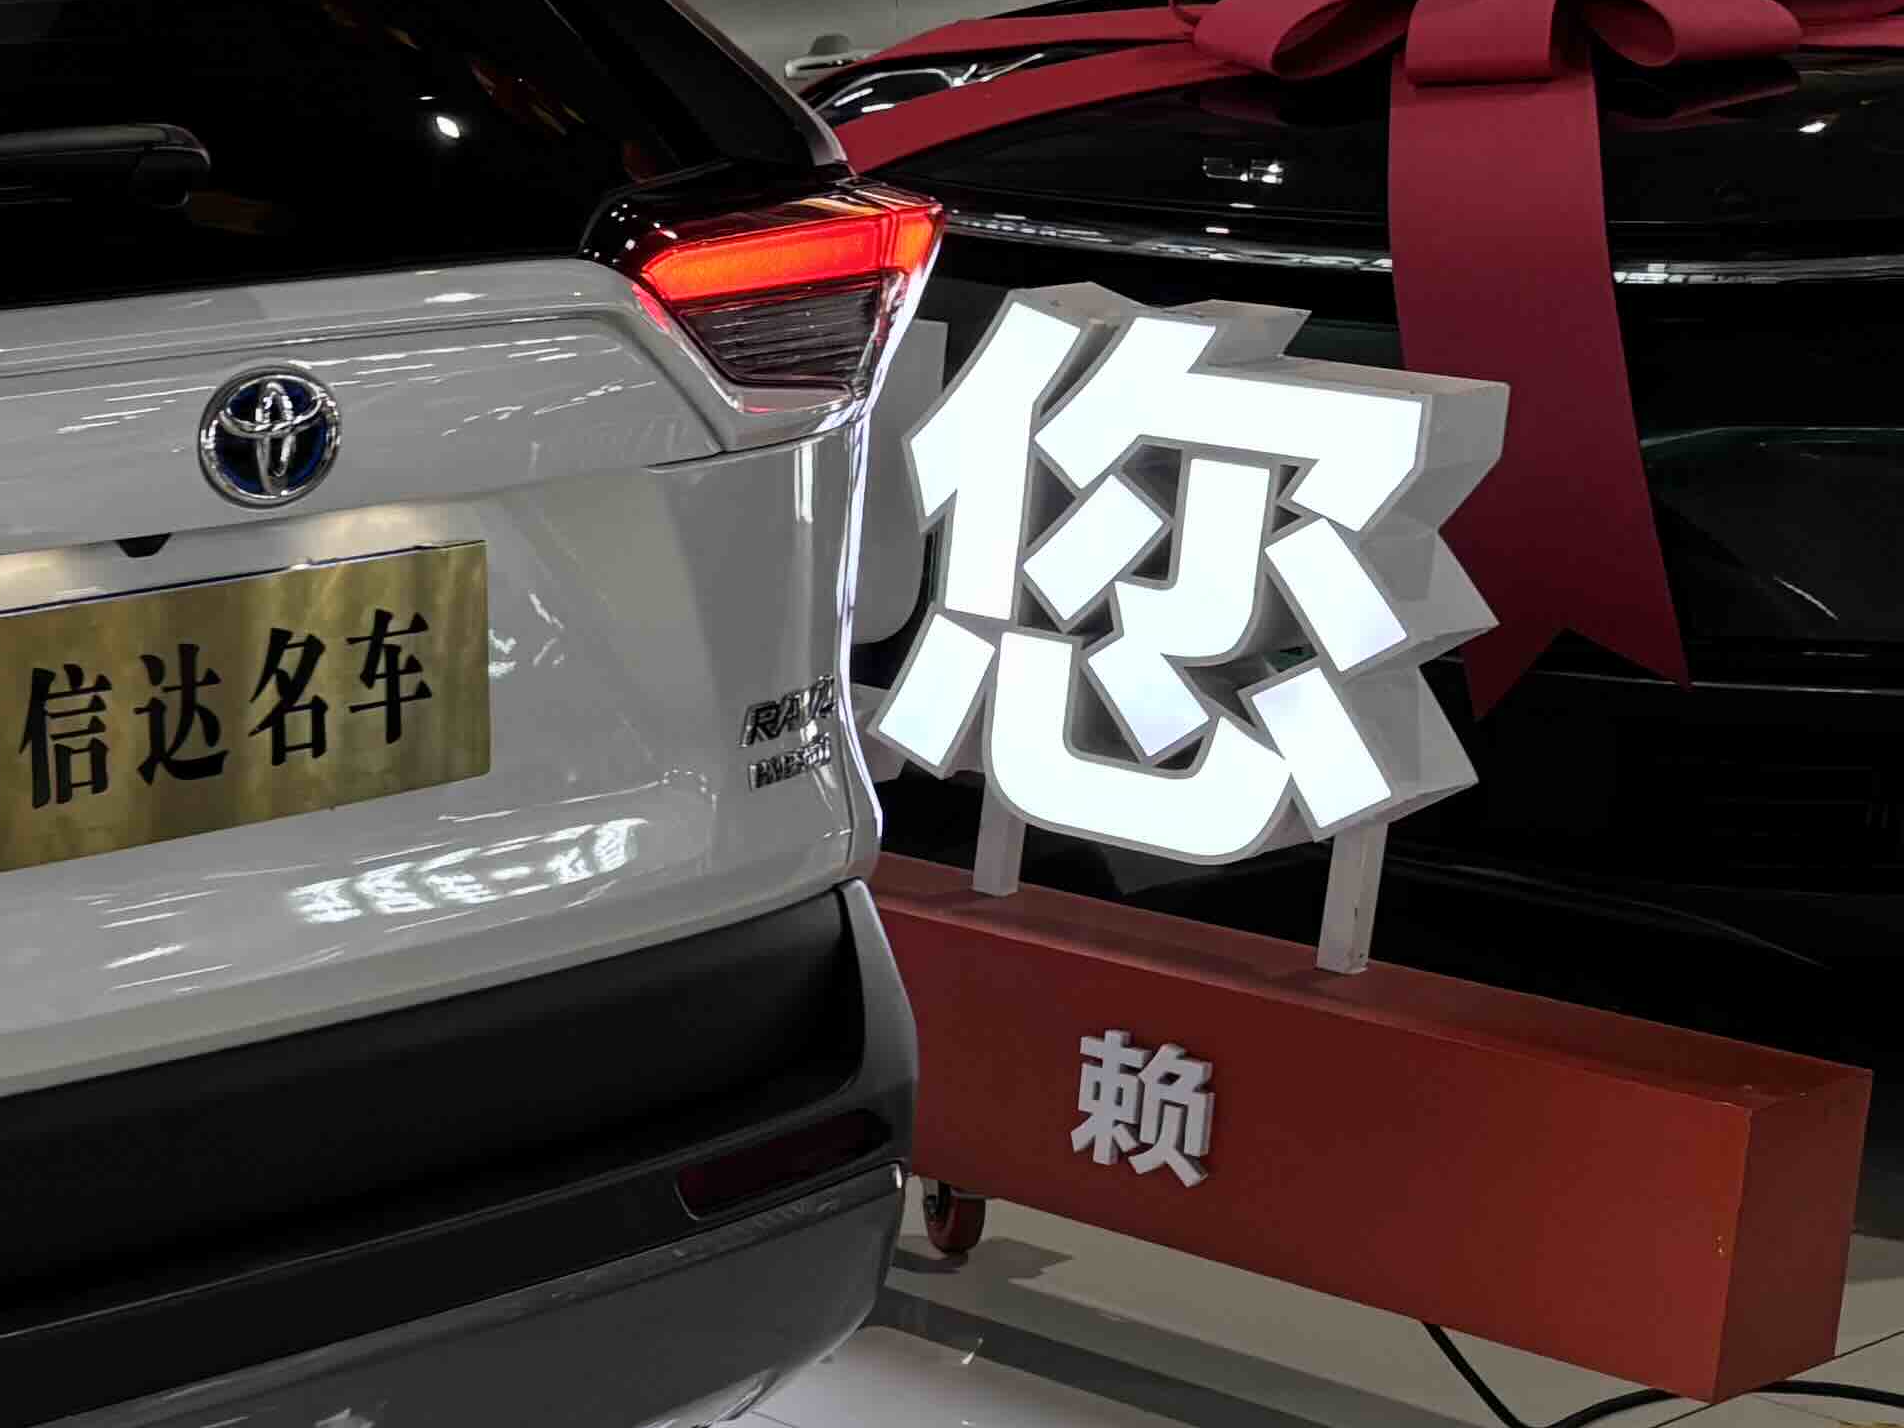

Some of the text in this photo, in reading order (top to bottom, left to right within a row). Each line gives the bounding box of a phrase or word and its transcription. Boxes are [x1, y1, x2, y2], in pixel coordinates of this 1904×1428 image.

[868, 286, 1432, 864] 您
[18, 608, 434, 811] 信达名车
[1070, 1025, 1215, 1190] 赖
